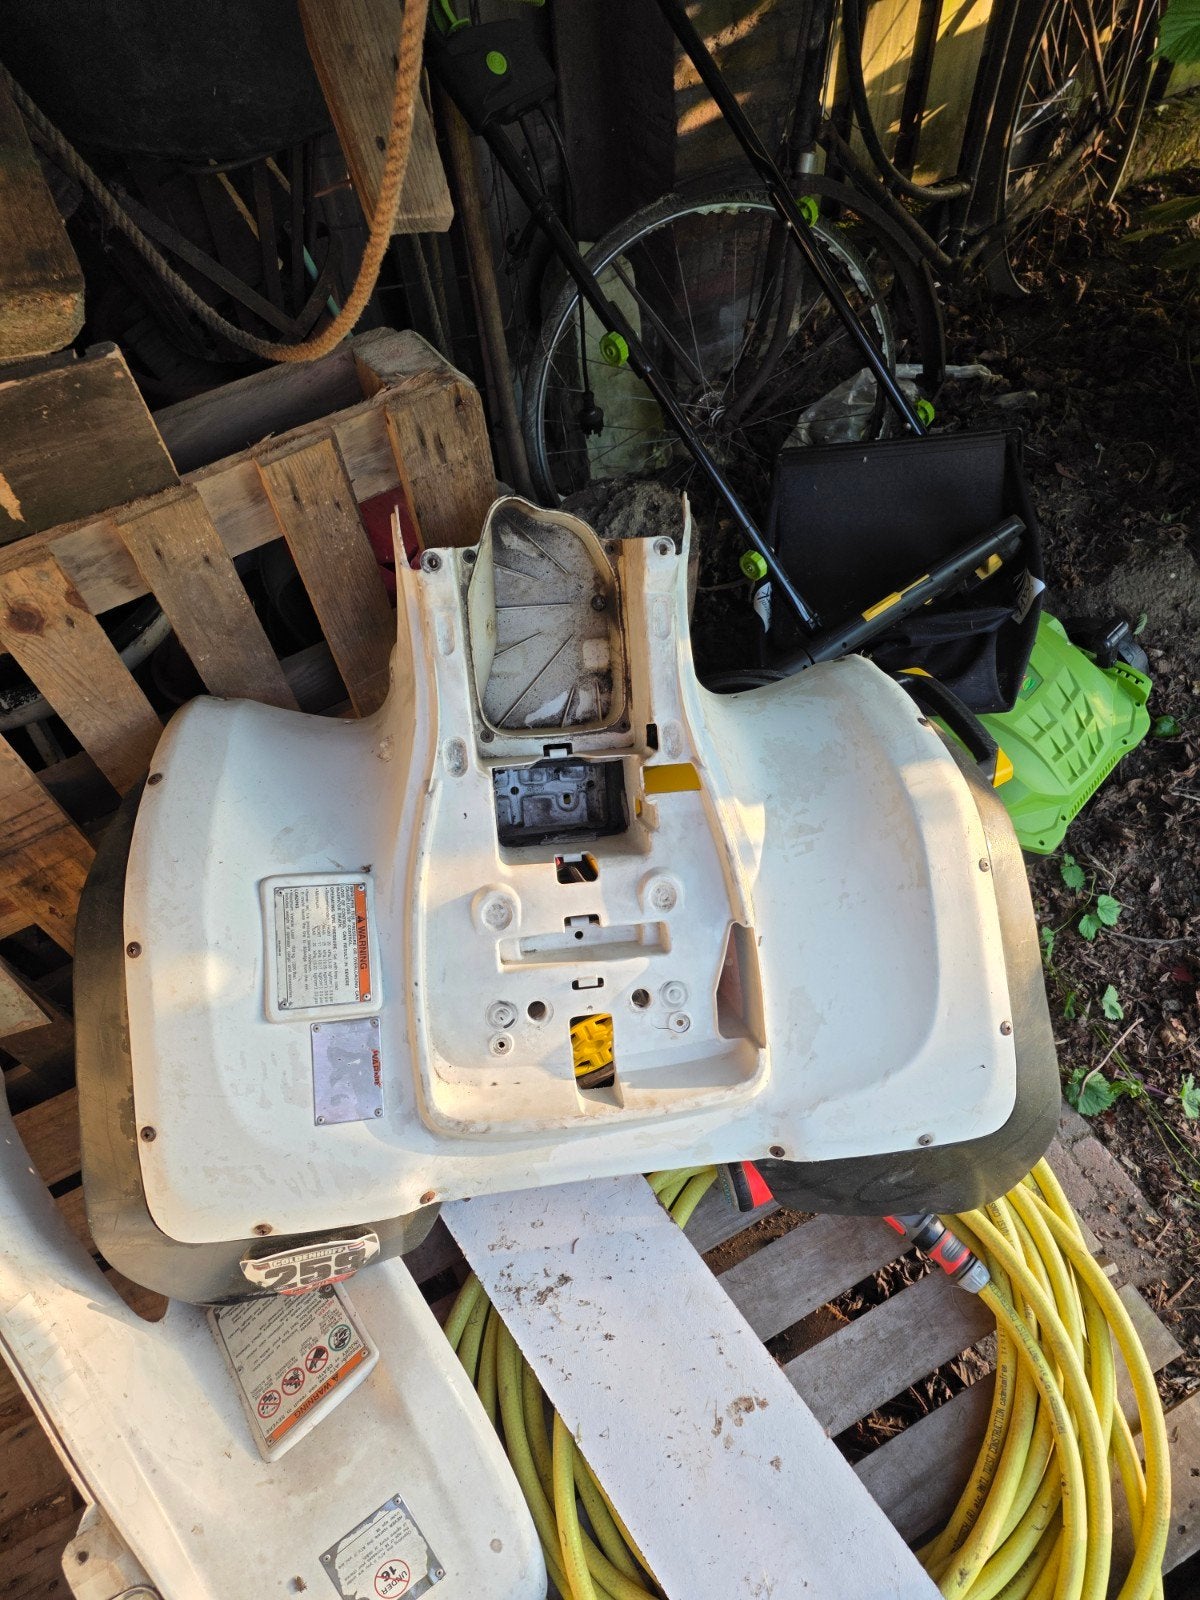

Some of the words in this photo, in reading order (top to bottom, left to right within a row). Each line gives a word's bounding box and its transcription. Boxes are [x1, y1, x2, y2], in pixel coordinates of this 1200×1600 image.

[357, 925, 366, 969] WARNING
[264, 1248, 366, 1290] 259
[1015, 1323, 1031, 1346] TWIST
[294, 1379, 333, 1419] WARNING
[265, 1413, 285, 1434] SEVERE
[977, 1477, 988, 1495] ANTI
[983, 1454, 994, 1476] TWIST
[388, 1514, 402, 1528] NEVER
[379, 1563, 397, 1582] 16
[380, 1569, 408, 1595] UNDER
